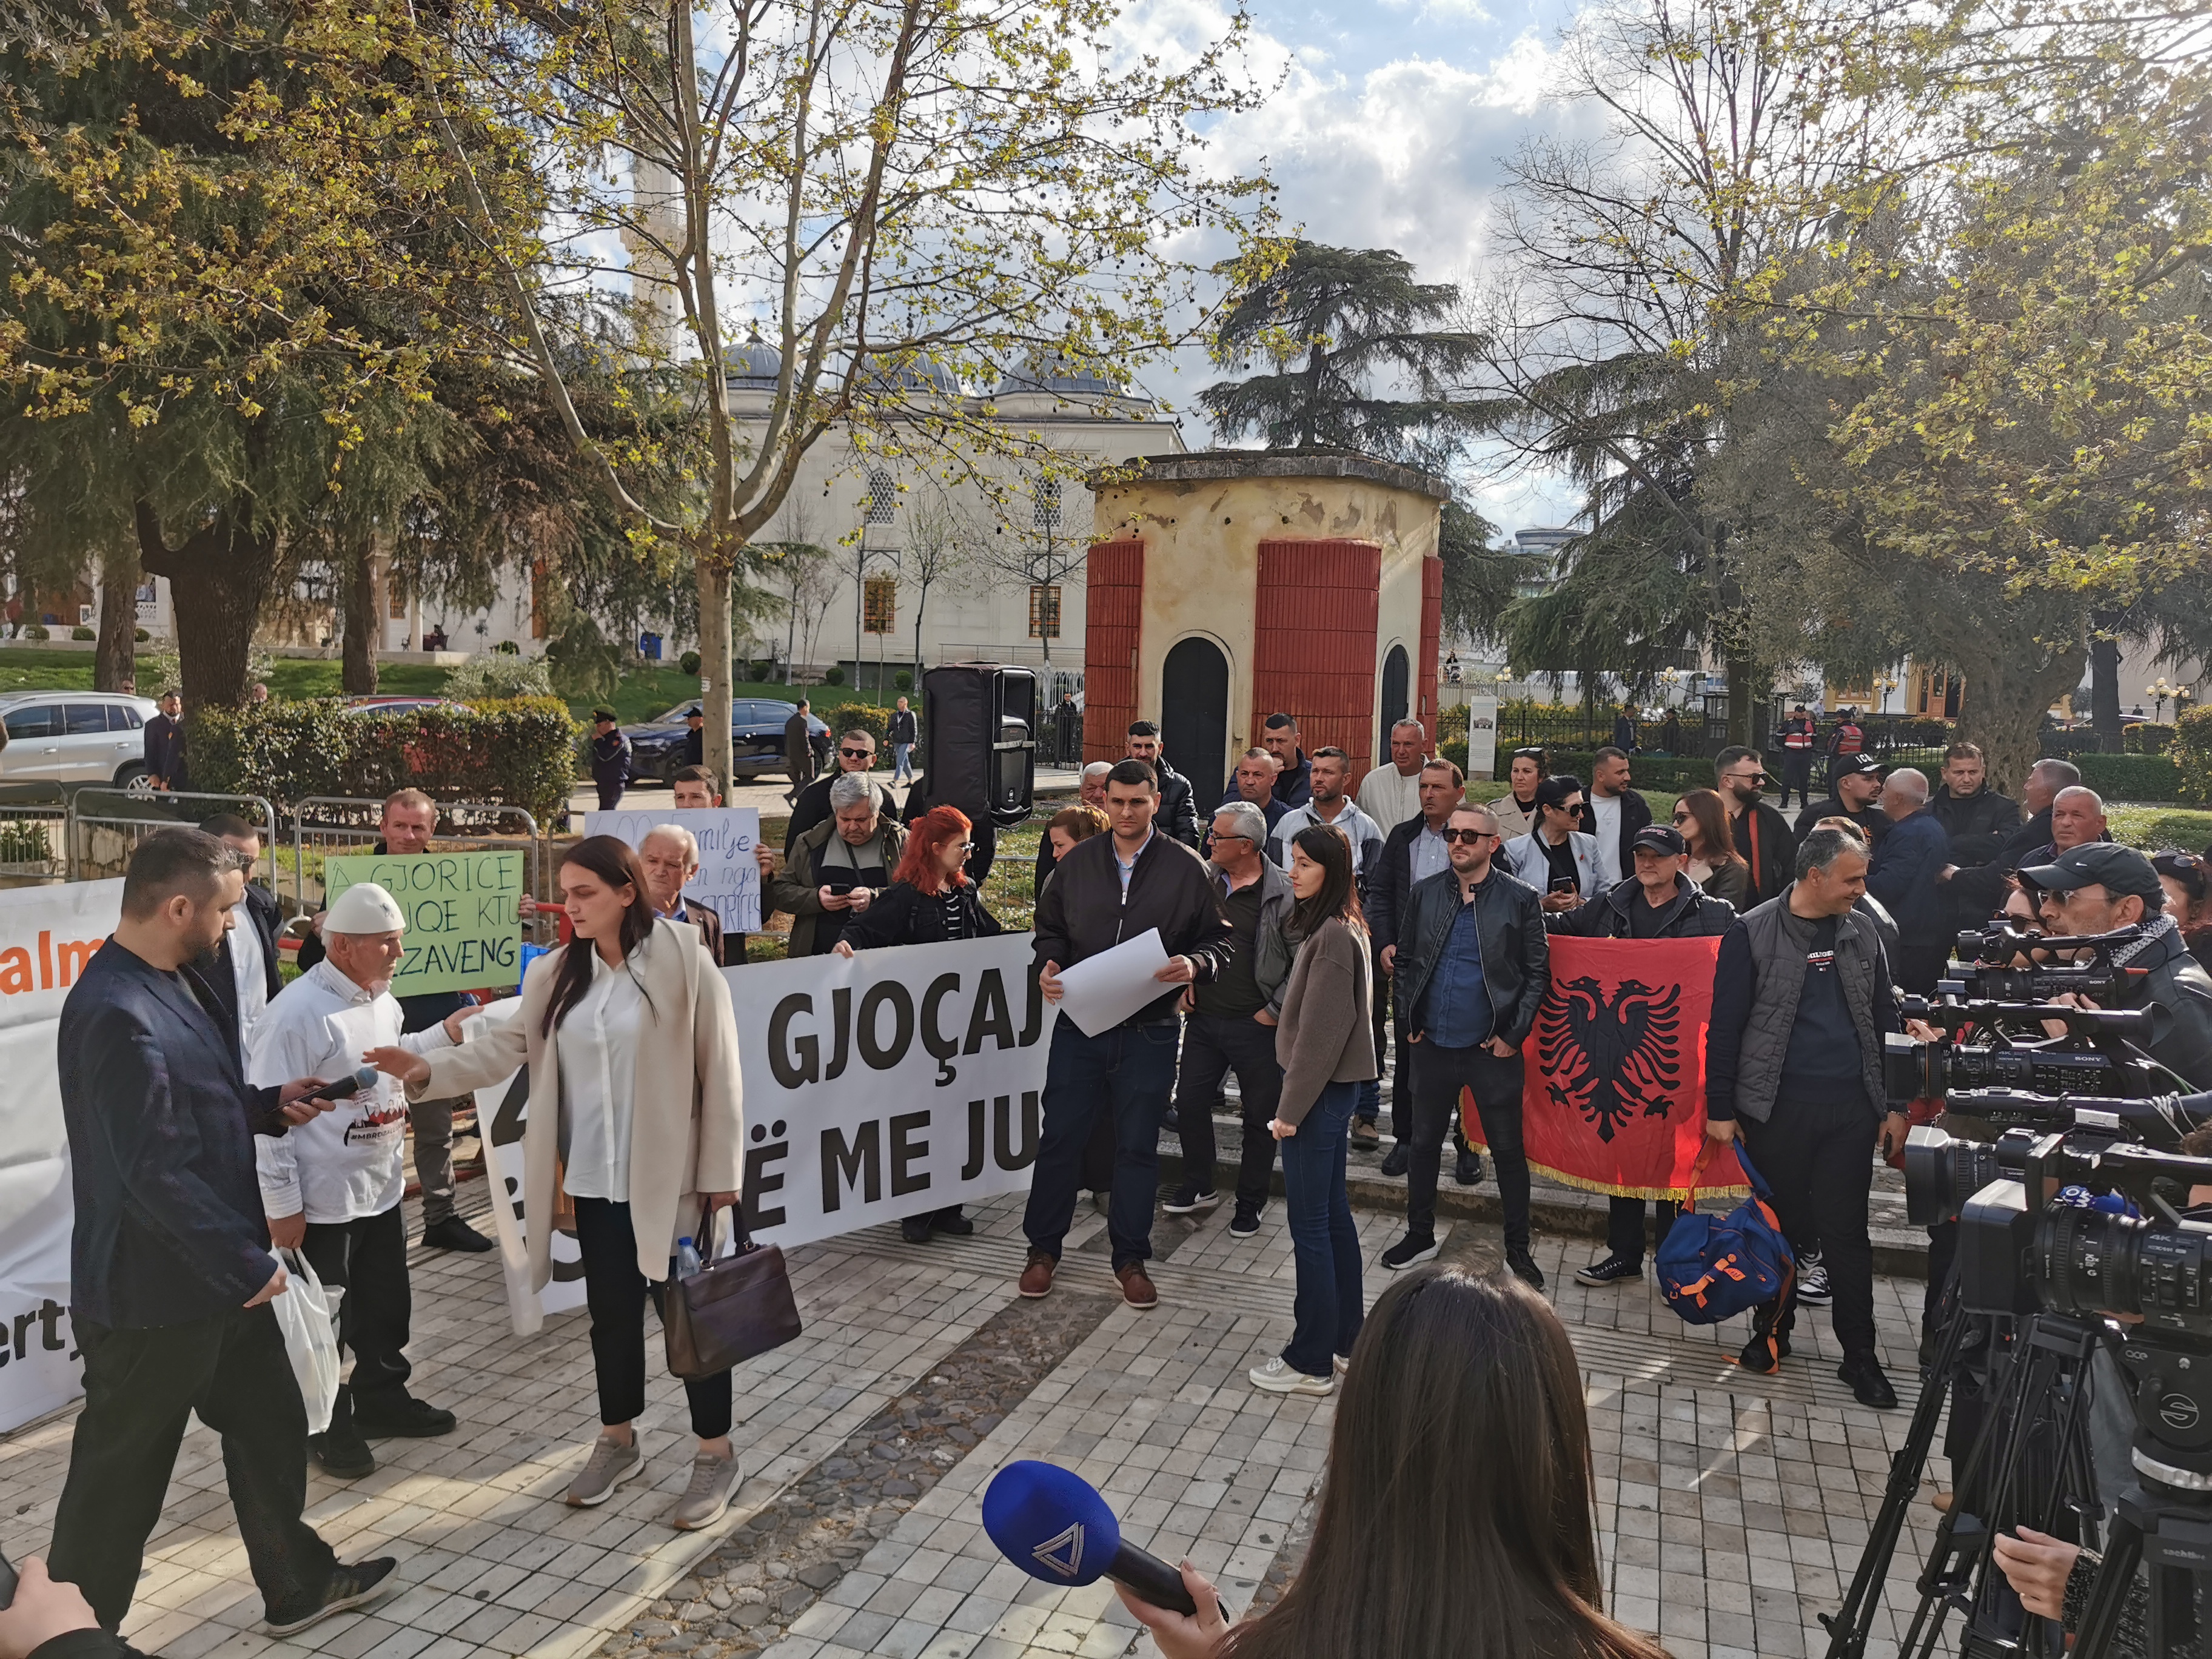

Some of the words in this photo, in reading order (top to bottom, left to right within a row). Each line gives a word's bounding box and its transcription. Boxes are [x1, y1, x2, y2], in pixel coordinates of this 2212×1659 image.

[722, 867, 757, 896] nga
[478, 894, 521, 928] KTU
[392, 937, 515, 977] ZAVENG
[768, 964, 1043, 1089] GJOÇAJ
[821, 1110, 931, 1213] ME
[2125, 1350, 2148, 1360] ace
